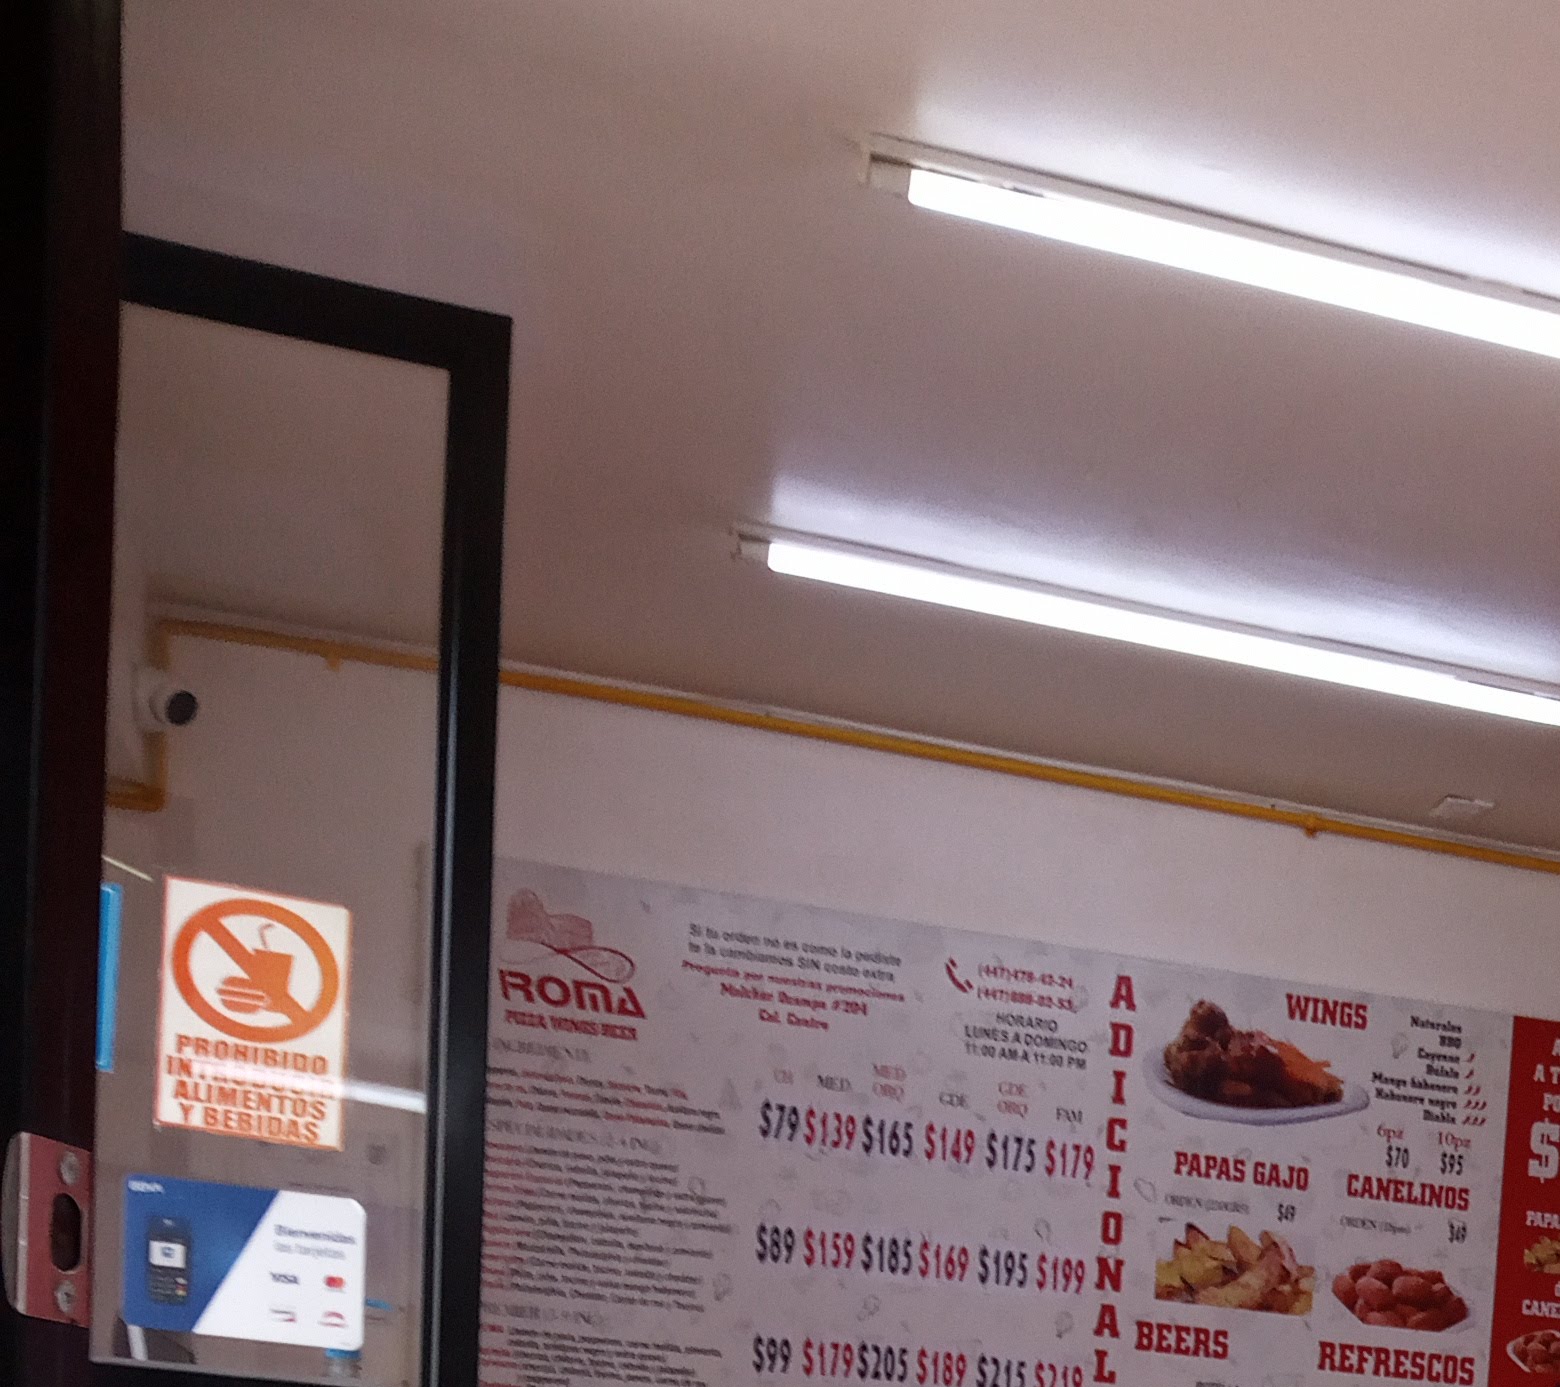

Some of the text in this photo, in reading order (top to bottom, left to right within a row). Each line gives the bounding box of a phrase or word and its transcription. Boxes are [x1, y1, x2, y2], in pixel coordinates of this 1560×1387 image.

[497, 968, 648, 1020] ROMA
[1285, 992, 1369, 1031] WINGS
[997, 1012, 1058, 1033] HORARIO
[1024, 1033, 1088, 1053] DOMINGO
[1410, 1015, 1463, 1034] Naturales
[174, 1033, 329, 1076] PROHIBIDO
[1533, 1063, 1546, 1083] A
[174, 1078, 327, 1122] ALIMENTOS
[179, 1102, 321, 1145] Y BEBIDAS
[759, 1098, 799, 1141] $79
[803, 1105, 857, 1150] $139
[862, 1114, 913, 1158] $165
[924, 1122, 975, 1165] $149
[986, 1128, 1036, 1174] $175
[1045, 1139, 1095, 1180] $179
[1174, 1151, 1310, 1192] PAPAS GAJO
[1385, 1145, 1464, 1176] $70 $95
[1346, 1173, 1471, 1212] CANELINOS
[756, 1222, 1085, 1295] $89 $159 $185 $169 $195 $199
[752, 1332, 792, 1374] $99
[802, 1337, 854, 1377] $179
[857, 1341, 909, 1383] $205
[916, 1346, 967, 1387] $189
[1135, 1320, 1230, 1360] BEERS
[1318, 1340, 1475, 1386] REFRESCOS
